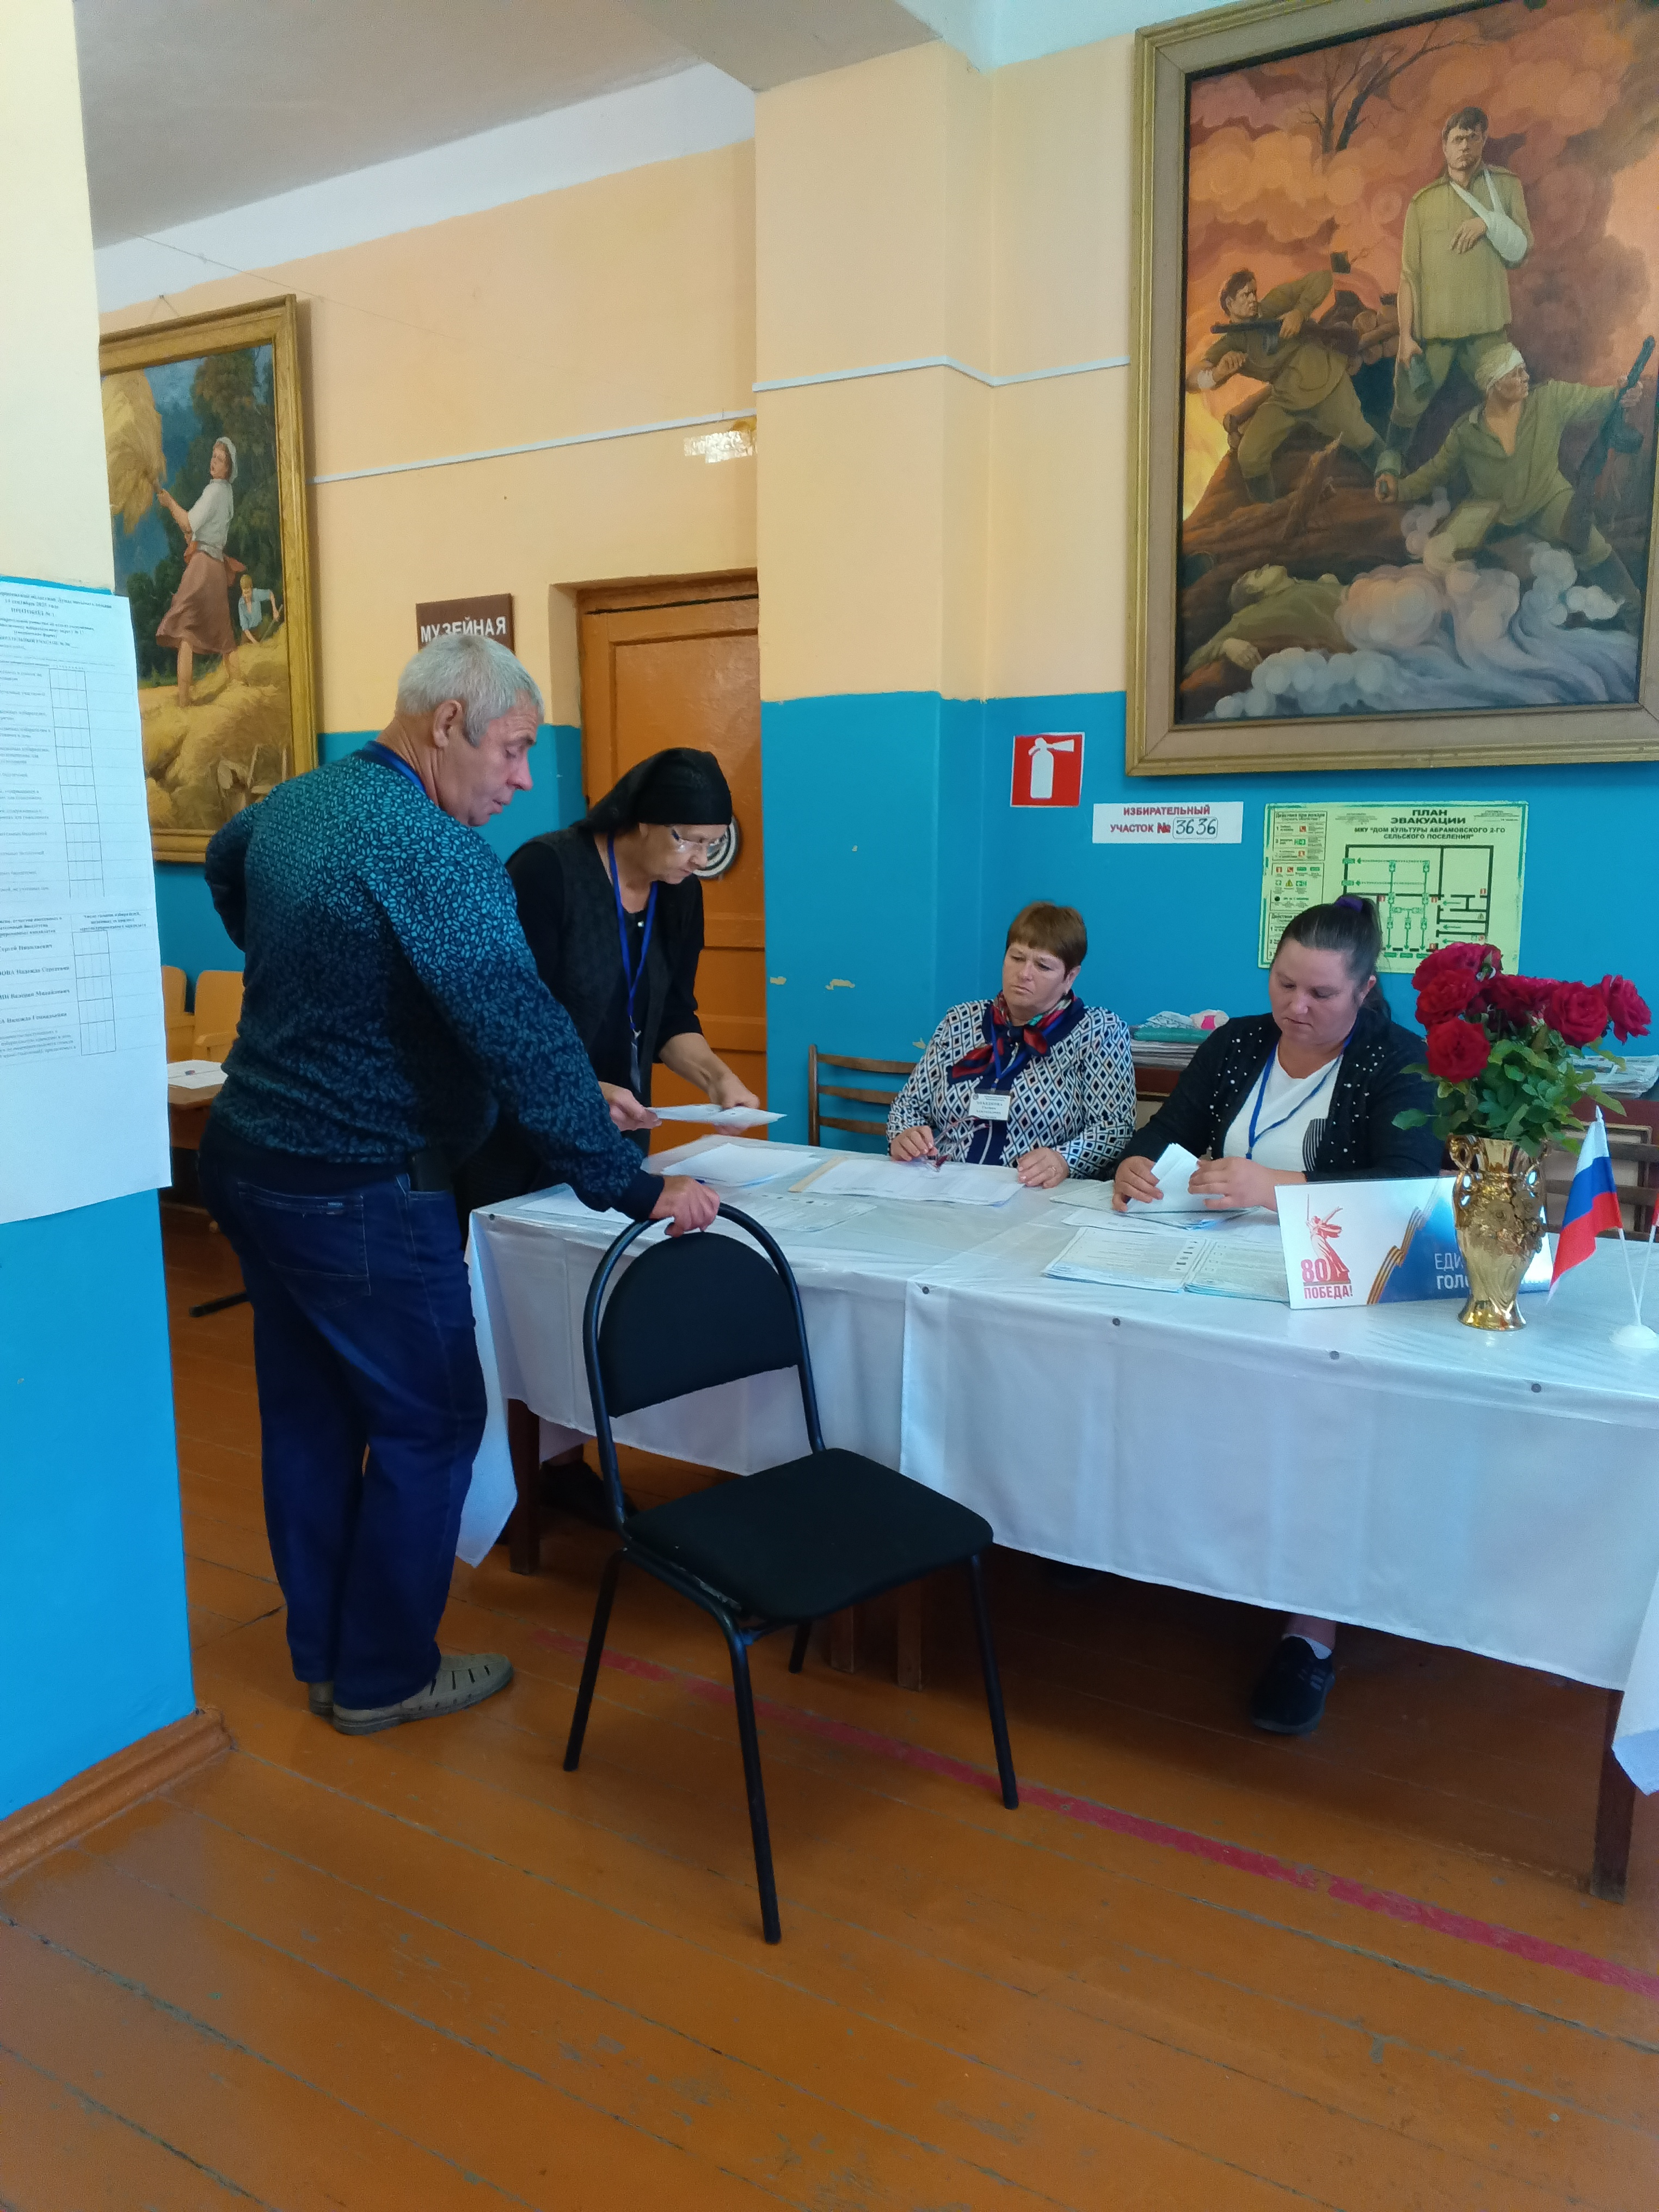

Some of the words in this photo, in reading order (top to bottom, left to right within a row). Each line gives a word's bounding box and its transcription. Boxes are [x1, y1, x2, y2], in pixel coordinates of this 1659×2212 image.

[1123, 804, 1211, 816] ИЗБИРАТЕЛЬНЫЙ
[1110, 824, 1154, 833] УЧАСТОК
[1175, 818, 1216, 835] 3636
[1390, 817, 1466, 825] ЭВАКУАЦИИ
[1300, 1258, 1329, 1283] 80
[1304, 1285, 1353, 1300] ПОБЕДА!
